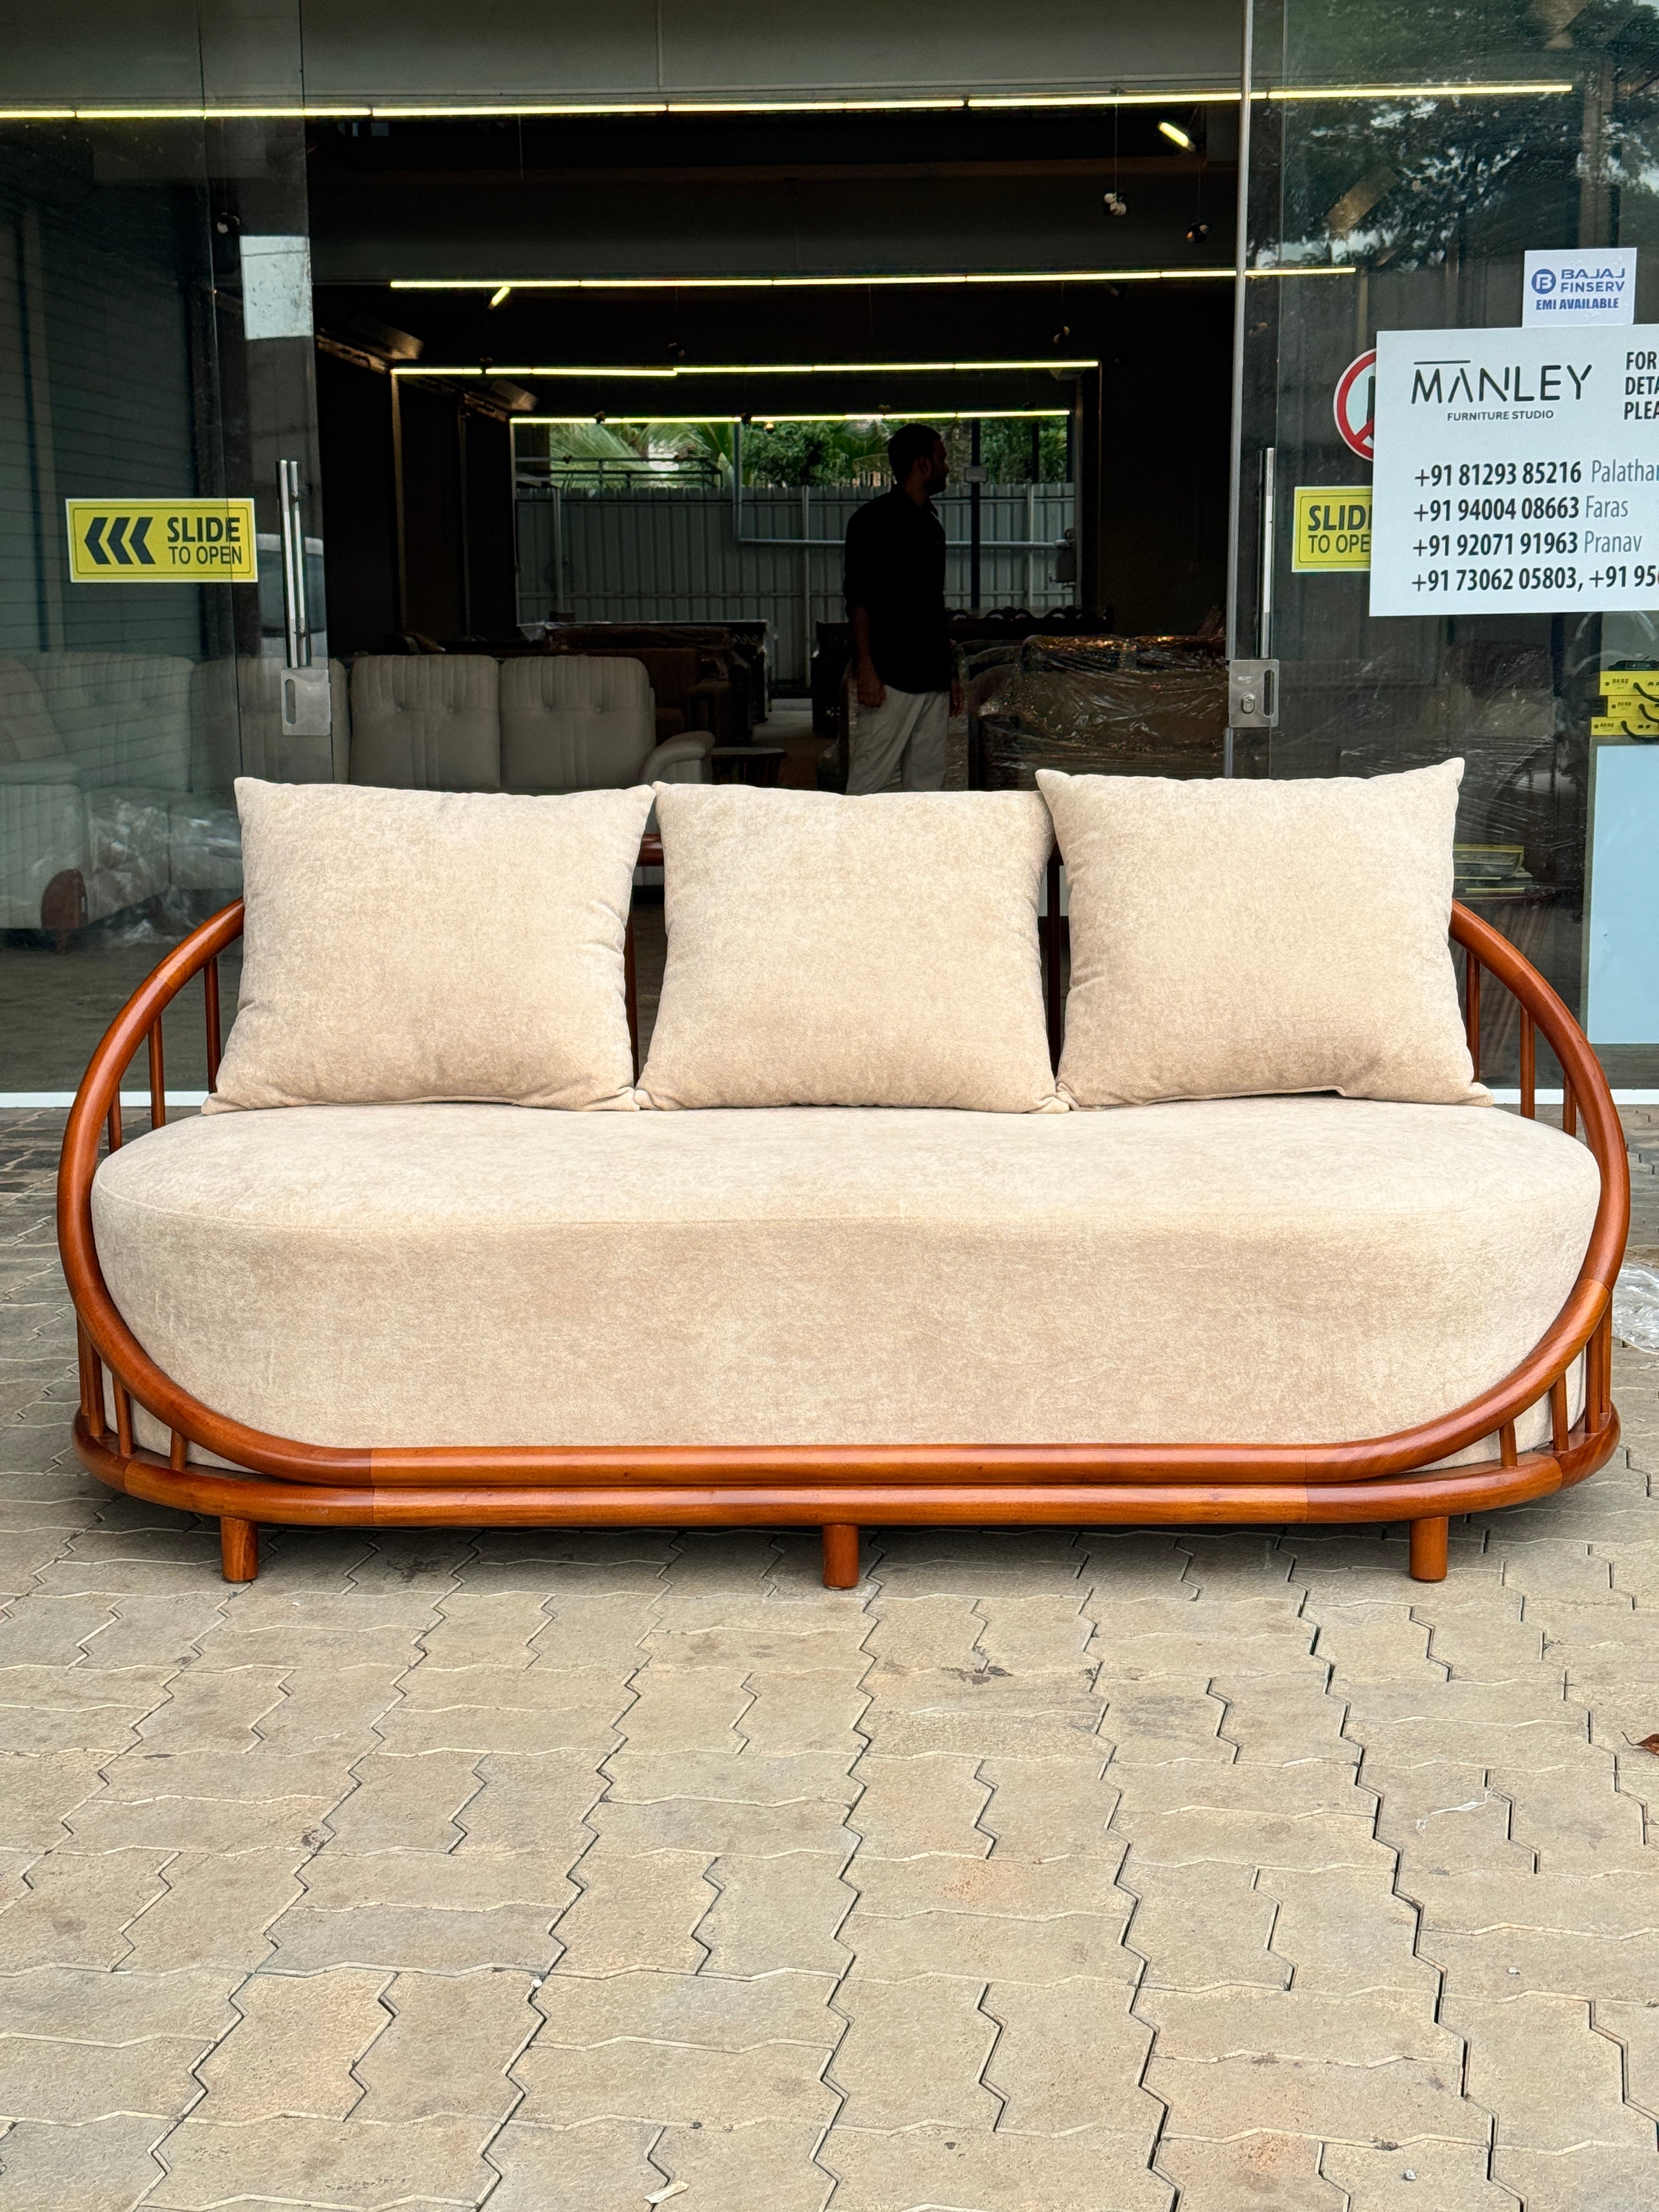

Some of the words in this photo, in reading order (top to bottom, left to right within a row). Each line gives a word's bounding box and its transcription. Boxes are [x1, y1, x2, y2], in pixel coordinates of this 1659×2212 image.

[1561, 268, 1625, 279] BAJAJ
[1560, 281, 1625, 293] FINSERV
[1536, 299, 1556, 310] EMI
[1559, 298, 1619, 309] AVAILABLE
[1626, 351, 1657, 370] FOR
[1447, 411, 1509, 421] FURNITURE
[1511, 410, 1554, 420] STUDIO
[1414, 464, 1452, 487] +91
[1459, 463, 1516, 486] 81293
[1522, 461, 1582, 484] 85216
[1413, 500, 1451, 522] +91
[1458, 498, 1516, 521] 94004
[1521, 496, 1579, 519] 08663
[1585, 495, 1628, 518] Faras
[167, 517, 240, 543] SLIDE
[1307, 534, 1330, 553] TO
[1413, 535, 1449, 557] +91
[1457, 533, 1513, 556] 92071
[1520, 532, 1578, 555] 91963
[1584, 531, 1642, 553] Pranav
[168, 546, 191, 565] TO
[196, 546, 242, 565] OPEN
[1412, 569, 1448, 591] +91
[1456, 568, 1513, 591] 73062
[1519, 567, 1583, 592] 05803,
[1589, 566, 1626, 588] +91
[1634, 565, 1659, 587] 95
